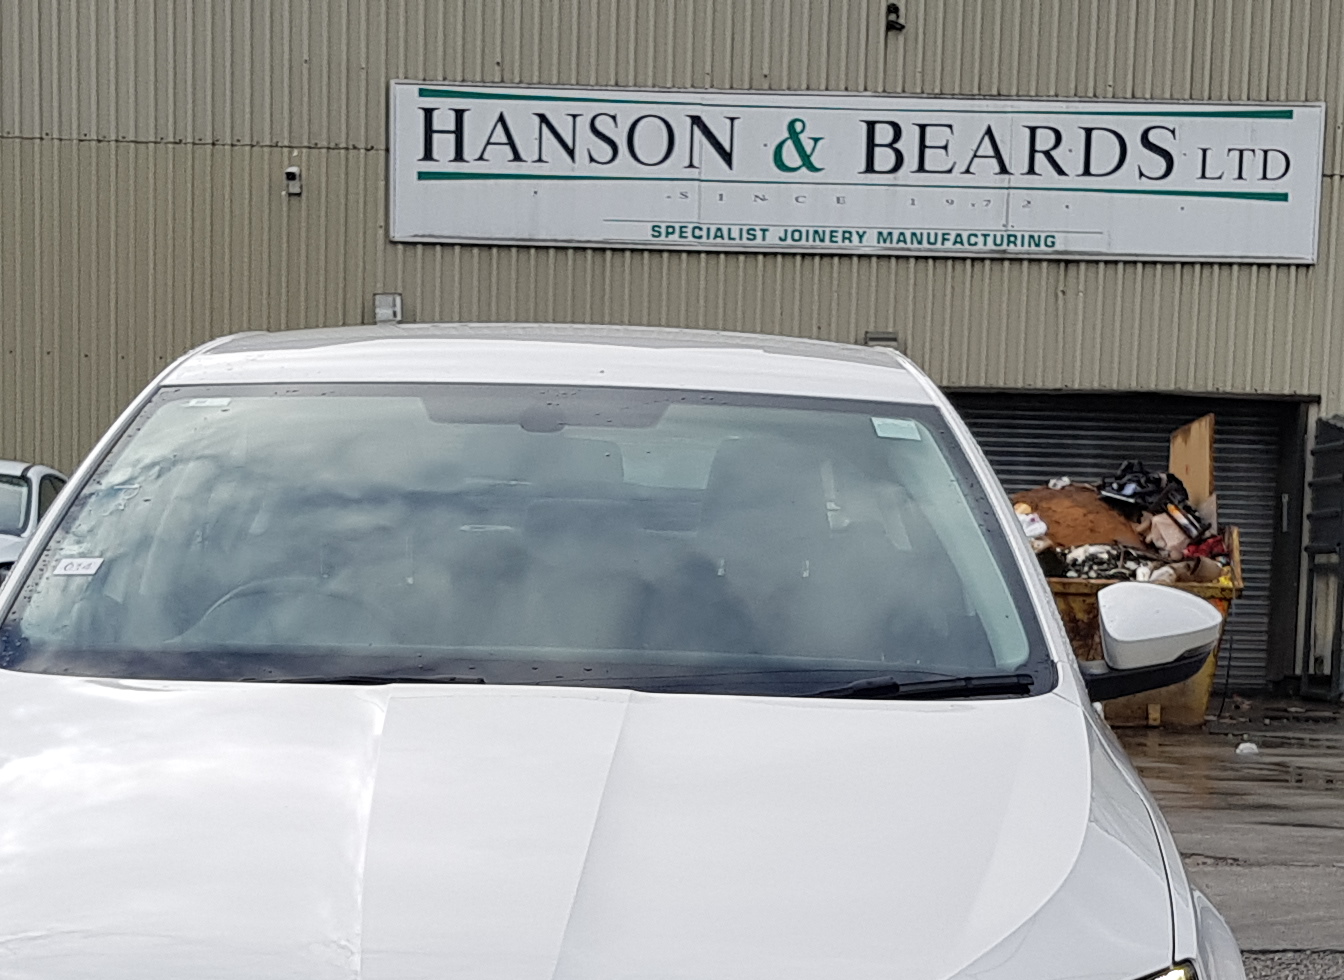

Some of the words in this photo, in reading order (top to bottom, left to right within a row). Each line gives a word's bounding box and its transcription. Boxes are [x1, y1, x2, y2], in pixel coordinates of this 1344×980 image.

[417, 106, 742, 172] HANSON
[772, 117, 826, 174] &
[857, 119, 1177, 182] BEARDS
[1195, 146, 1292, 182] LTD
[650, 224, 770, 243] SPECIALIST
[778, 227, 868, 246] JOINERY
[876, 229, 1058, 249] MANUFACTURING
